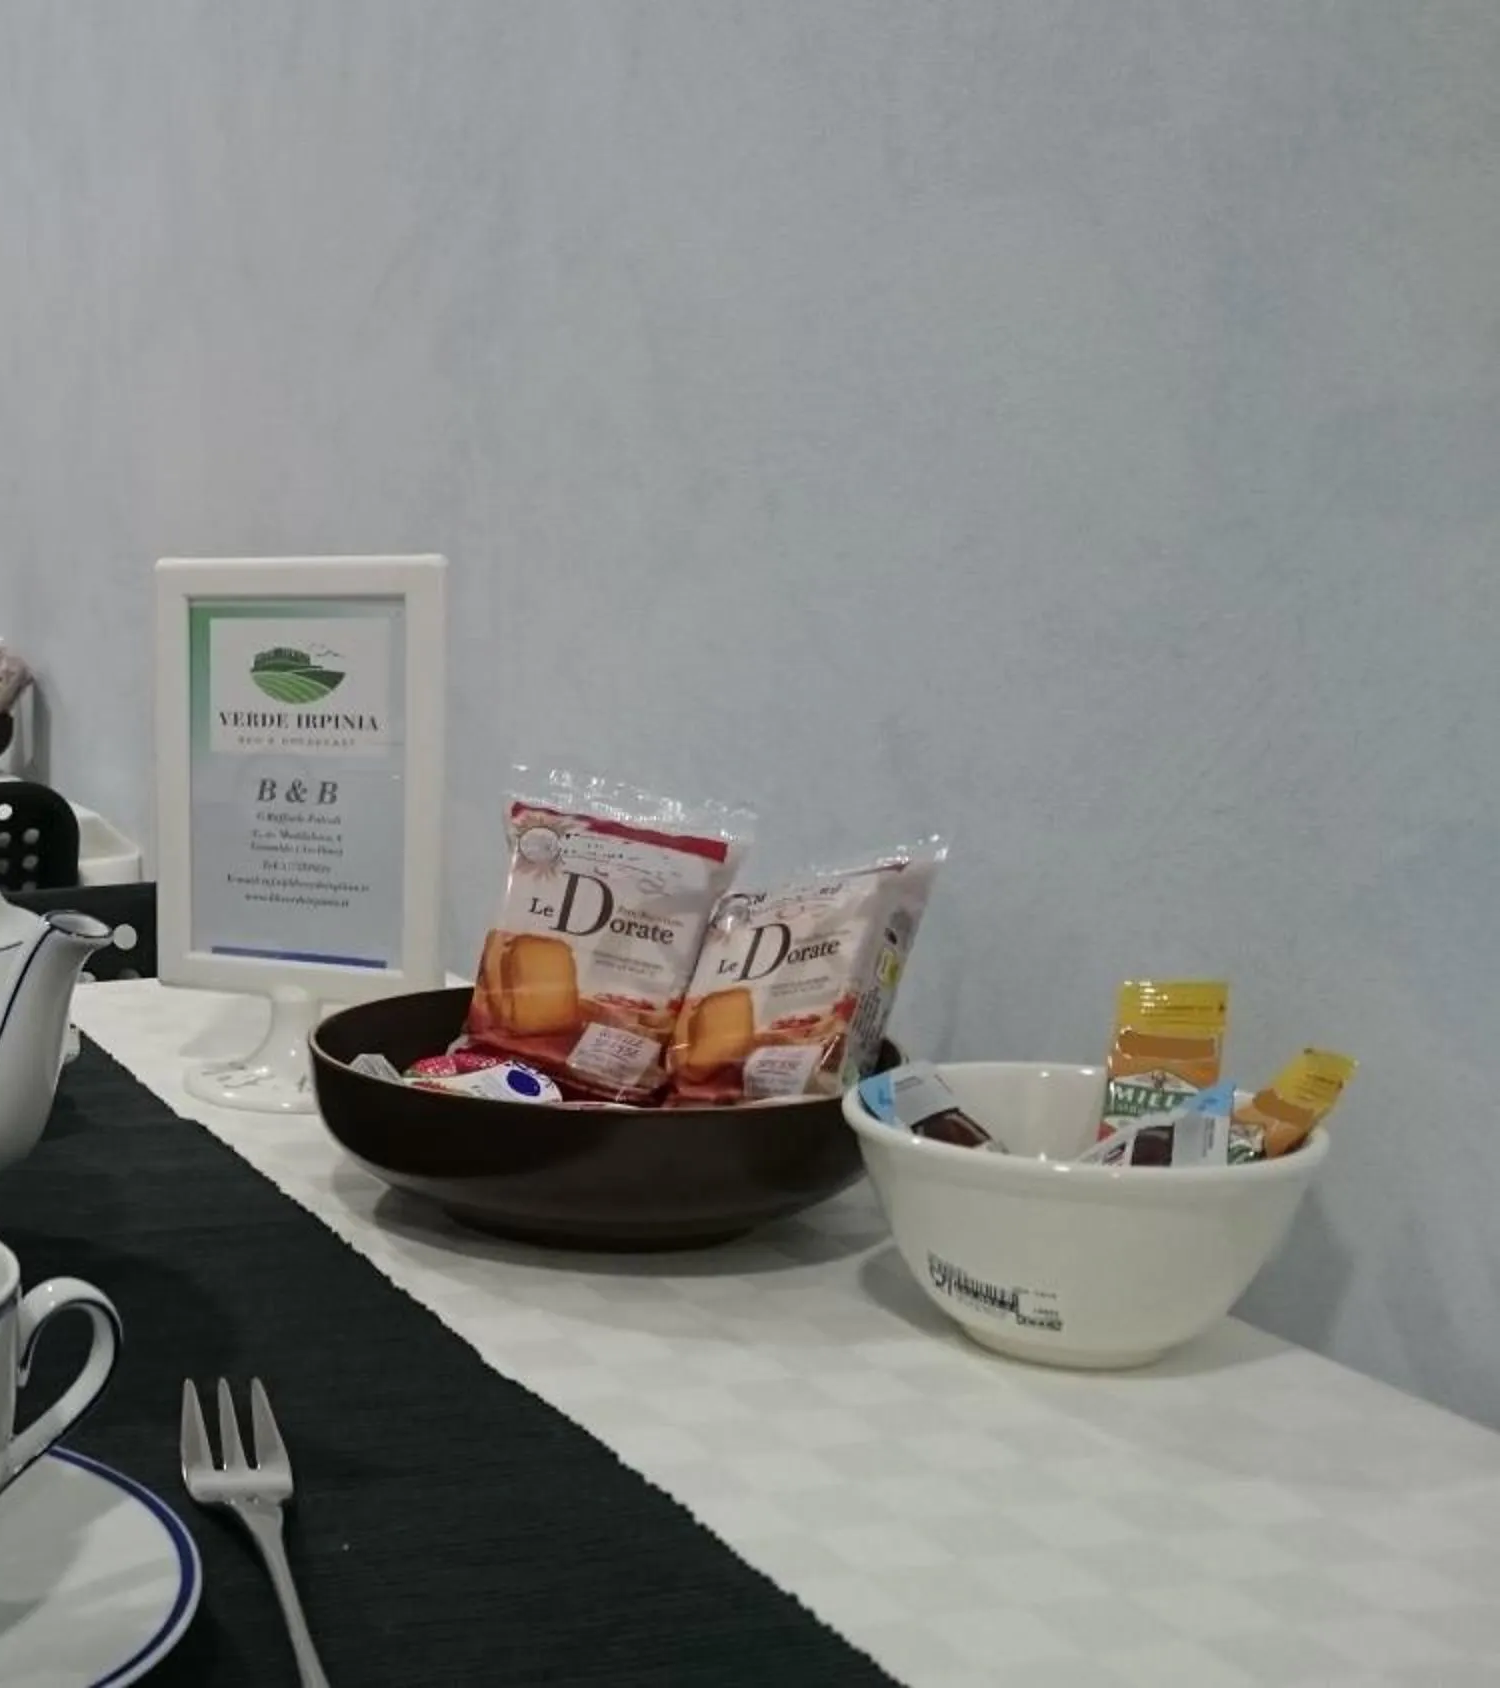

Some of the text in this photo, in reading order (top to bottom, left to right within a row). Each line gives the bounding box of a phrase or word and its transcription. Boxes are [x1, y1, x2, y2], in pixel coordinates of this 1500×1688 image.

[219, 711, 379, 732] VERDE IRPINIA
[256, 777, 339, 806] B & B
[529, 897, 555, 918] Le
[716, 958, 739, 976] Le
